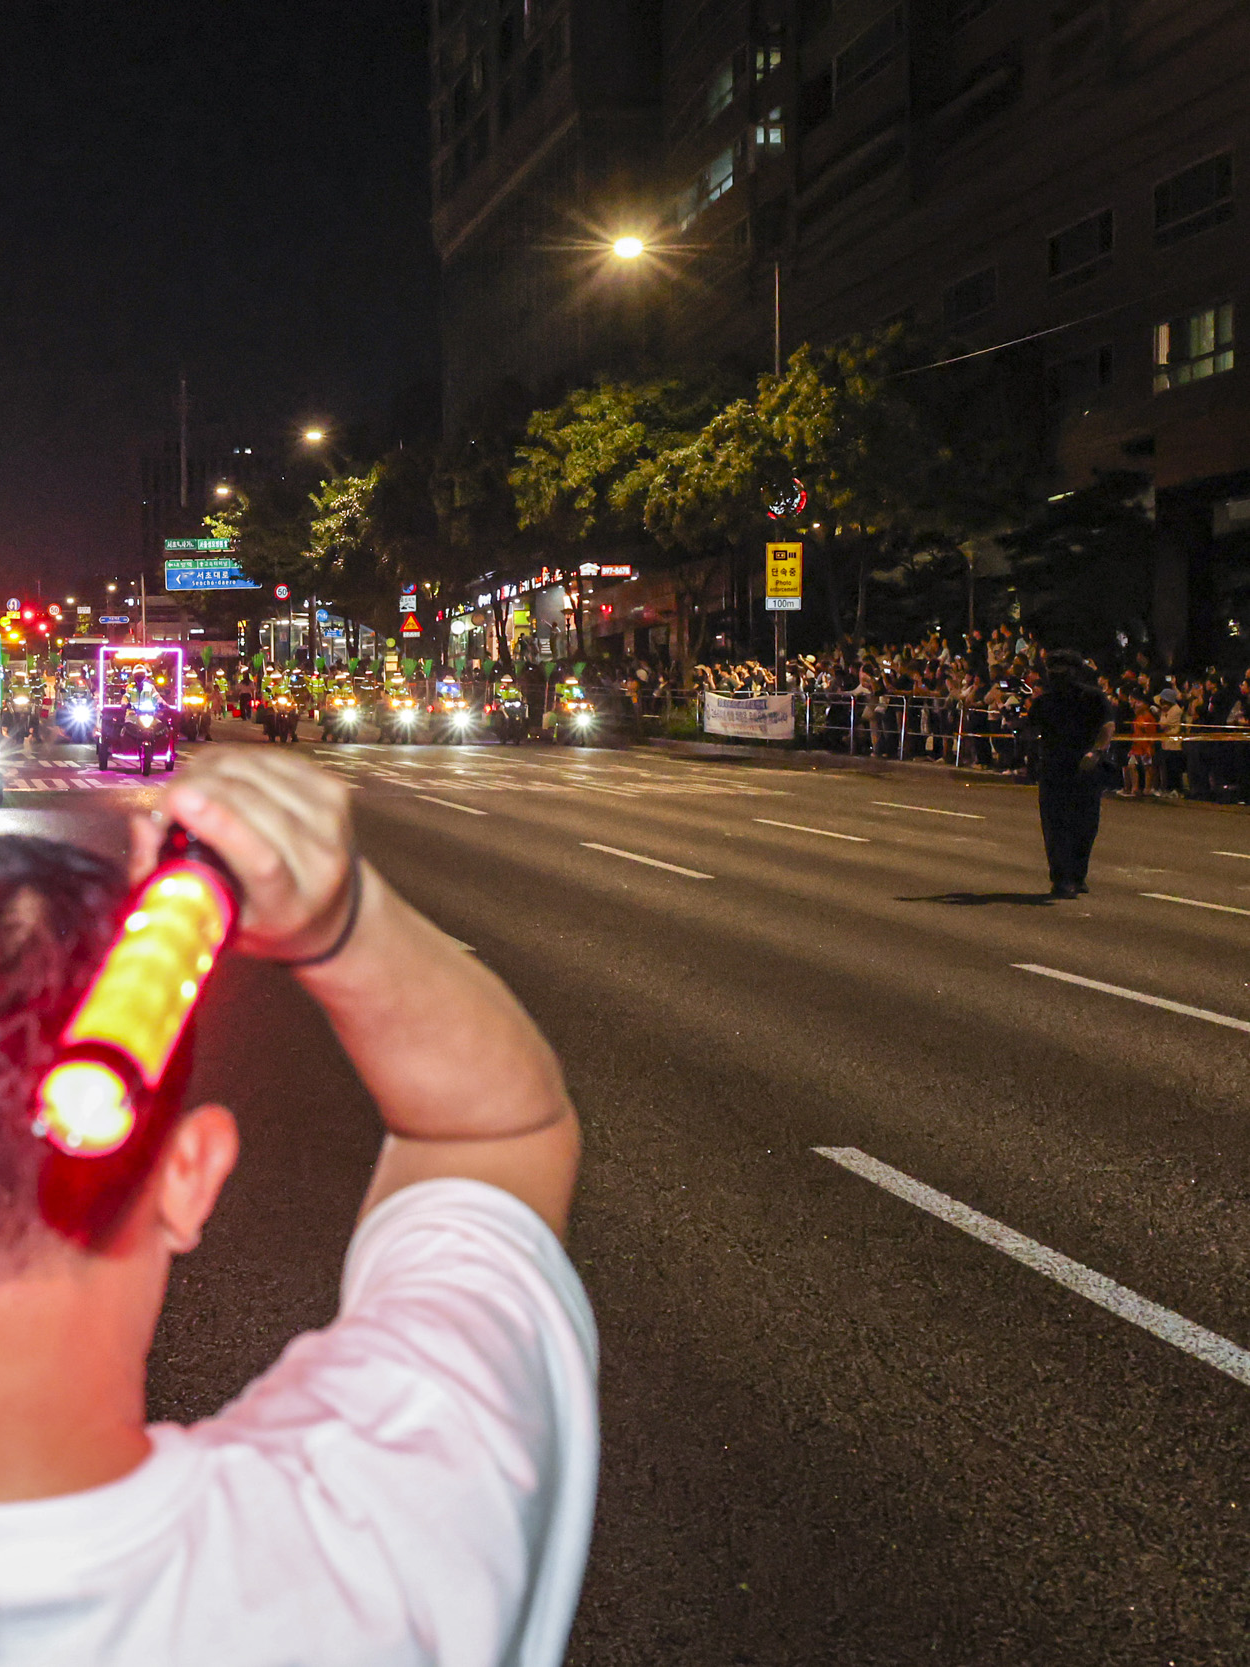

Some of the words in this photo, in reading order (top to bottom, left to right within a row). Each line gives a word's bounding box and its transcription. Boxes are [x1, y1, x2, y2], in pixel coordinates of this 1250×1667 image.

[196, 571, 229, 579] 서초대로
[771, 567, 796, 577] 단속중
[277, 588, 288, 596] 50
[772, 599, 795, 608] 100m
[50, 606, 59, 614] 50
